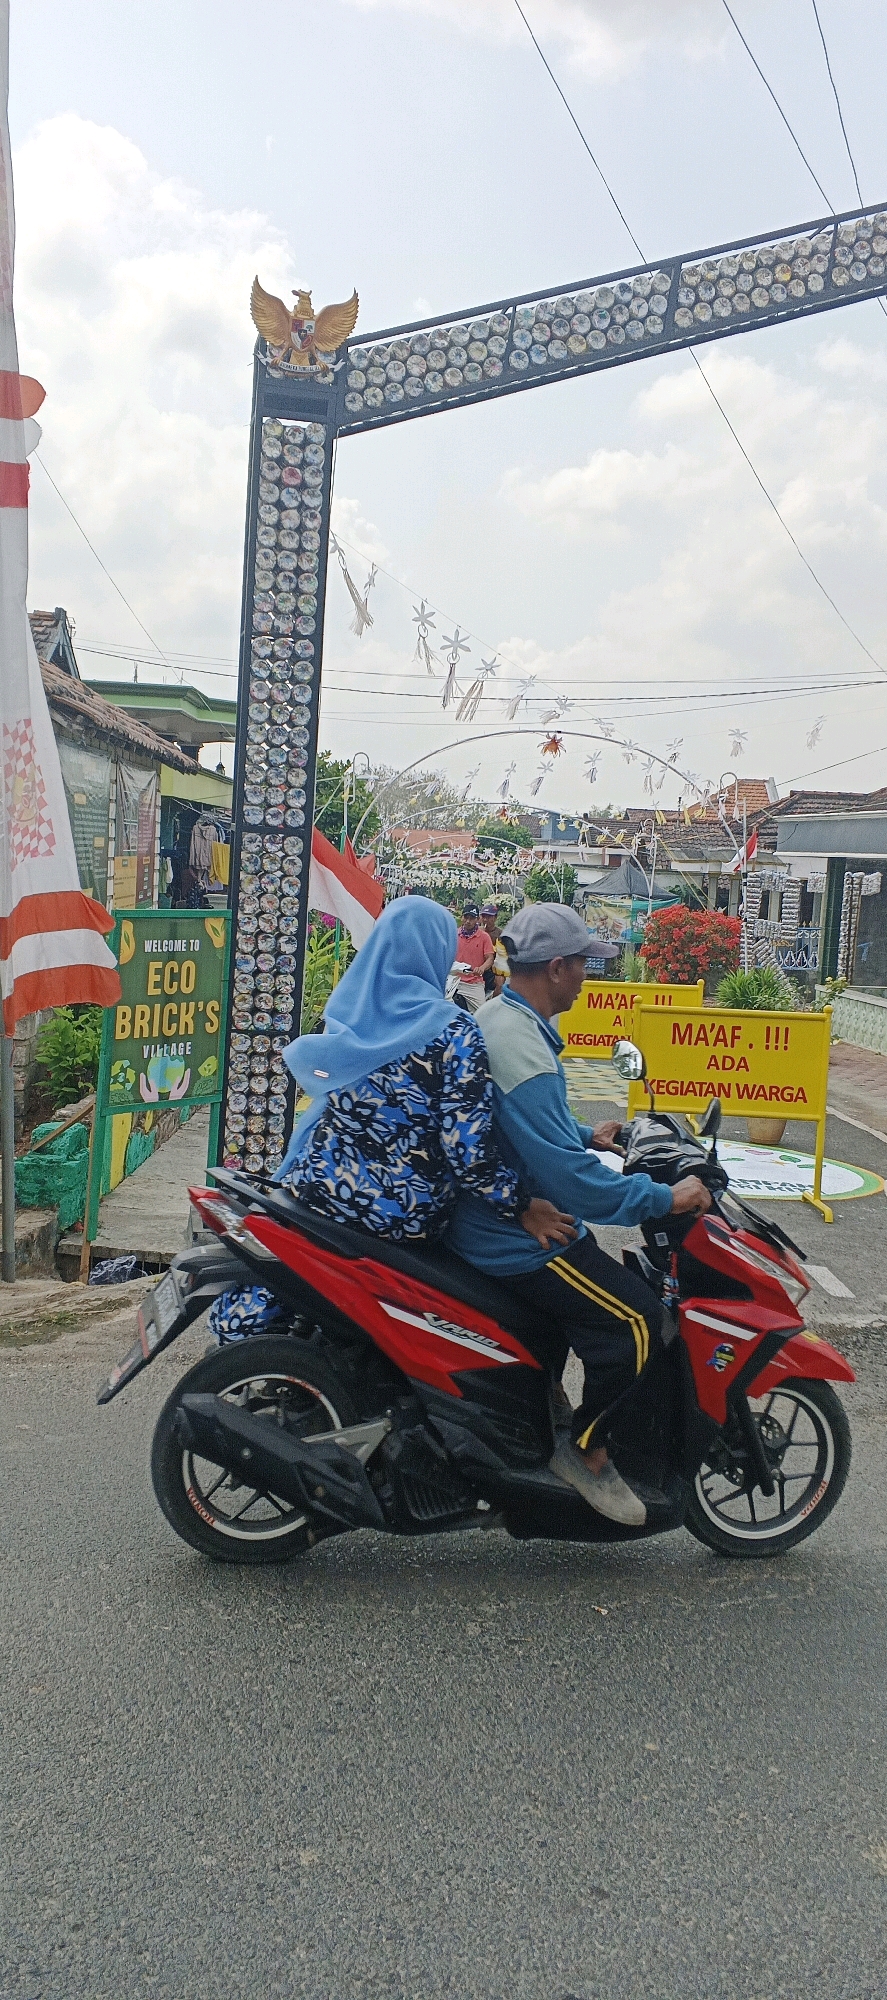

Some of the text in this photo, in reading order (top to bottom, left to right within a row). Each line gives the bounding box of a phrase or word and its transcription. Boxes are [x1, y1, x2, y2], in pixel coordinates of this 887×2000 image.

[144, 939, 200, 953] WELCOME TO
[147, 960, 196, 996] ECO
[114, 1000, 220, 1040] BRICK'S
[142, 1041, 192, 1059] VILLAGE
[671, 1022, 742, 1049] MA'AF
[764, 1025, 790, 1051] !!!
[706, 1054, 750, 1073] ADA
[643, 1078, 808, 1104] KEGIATAN WARGA
[422, 1312, 501, 1348] VARIO
